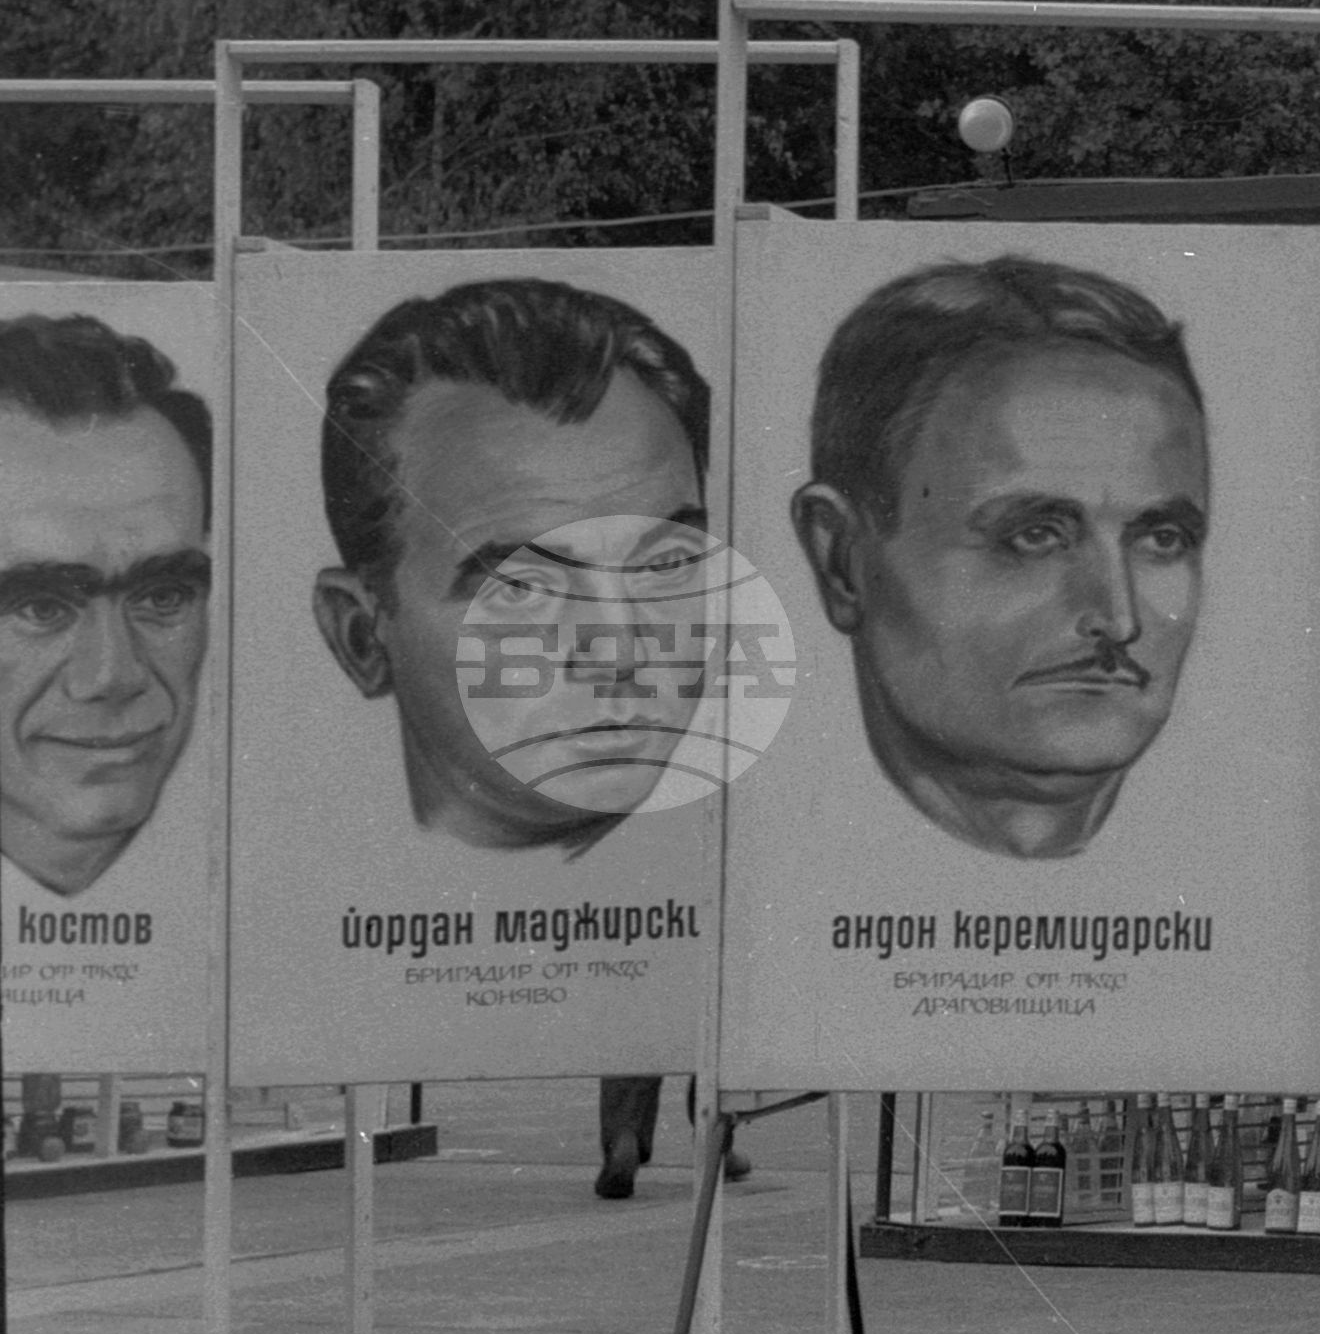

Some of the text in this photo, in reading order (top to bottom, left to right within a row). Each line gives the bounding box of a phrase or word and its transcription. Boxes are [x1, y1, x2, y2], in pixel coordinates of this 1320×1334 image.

[18, 905, 153, 945] костов
[341, 906, 474, 959] йордан
[831, 909, 1212, 962] андон керемидарски
[404, 963, 533, 985] БРИГАДИР
[541, 961, 578, 981] ОТ
[892, 971, 1015, 992] БРИГАДИР
[1024, 971, 1060, 990] ОТ
[465, 986, 568, 1007] КОНЯВО
[910, 996, 1097, 1017] ДРАГОВИЩИЦА
